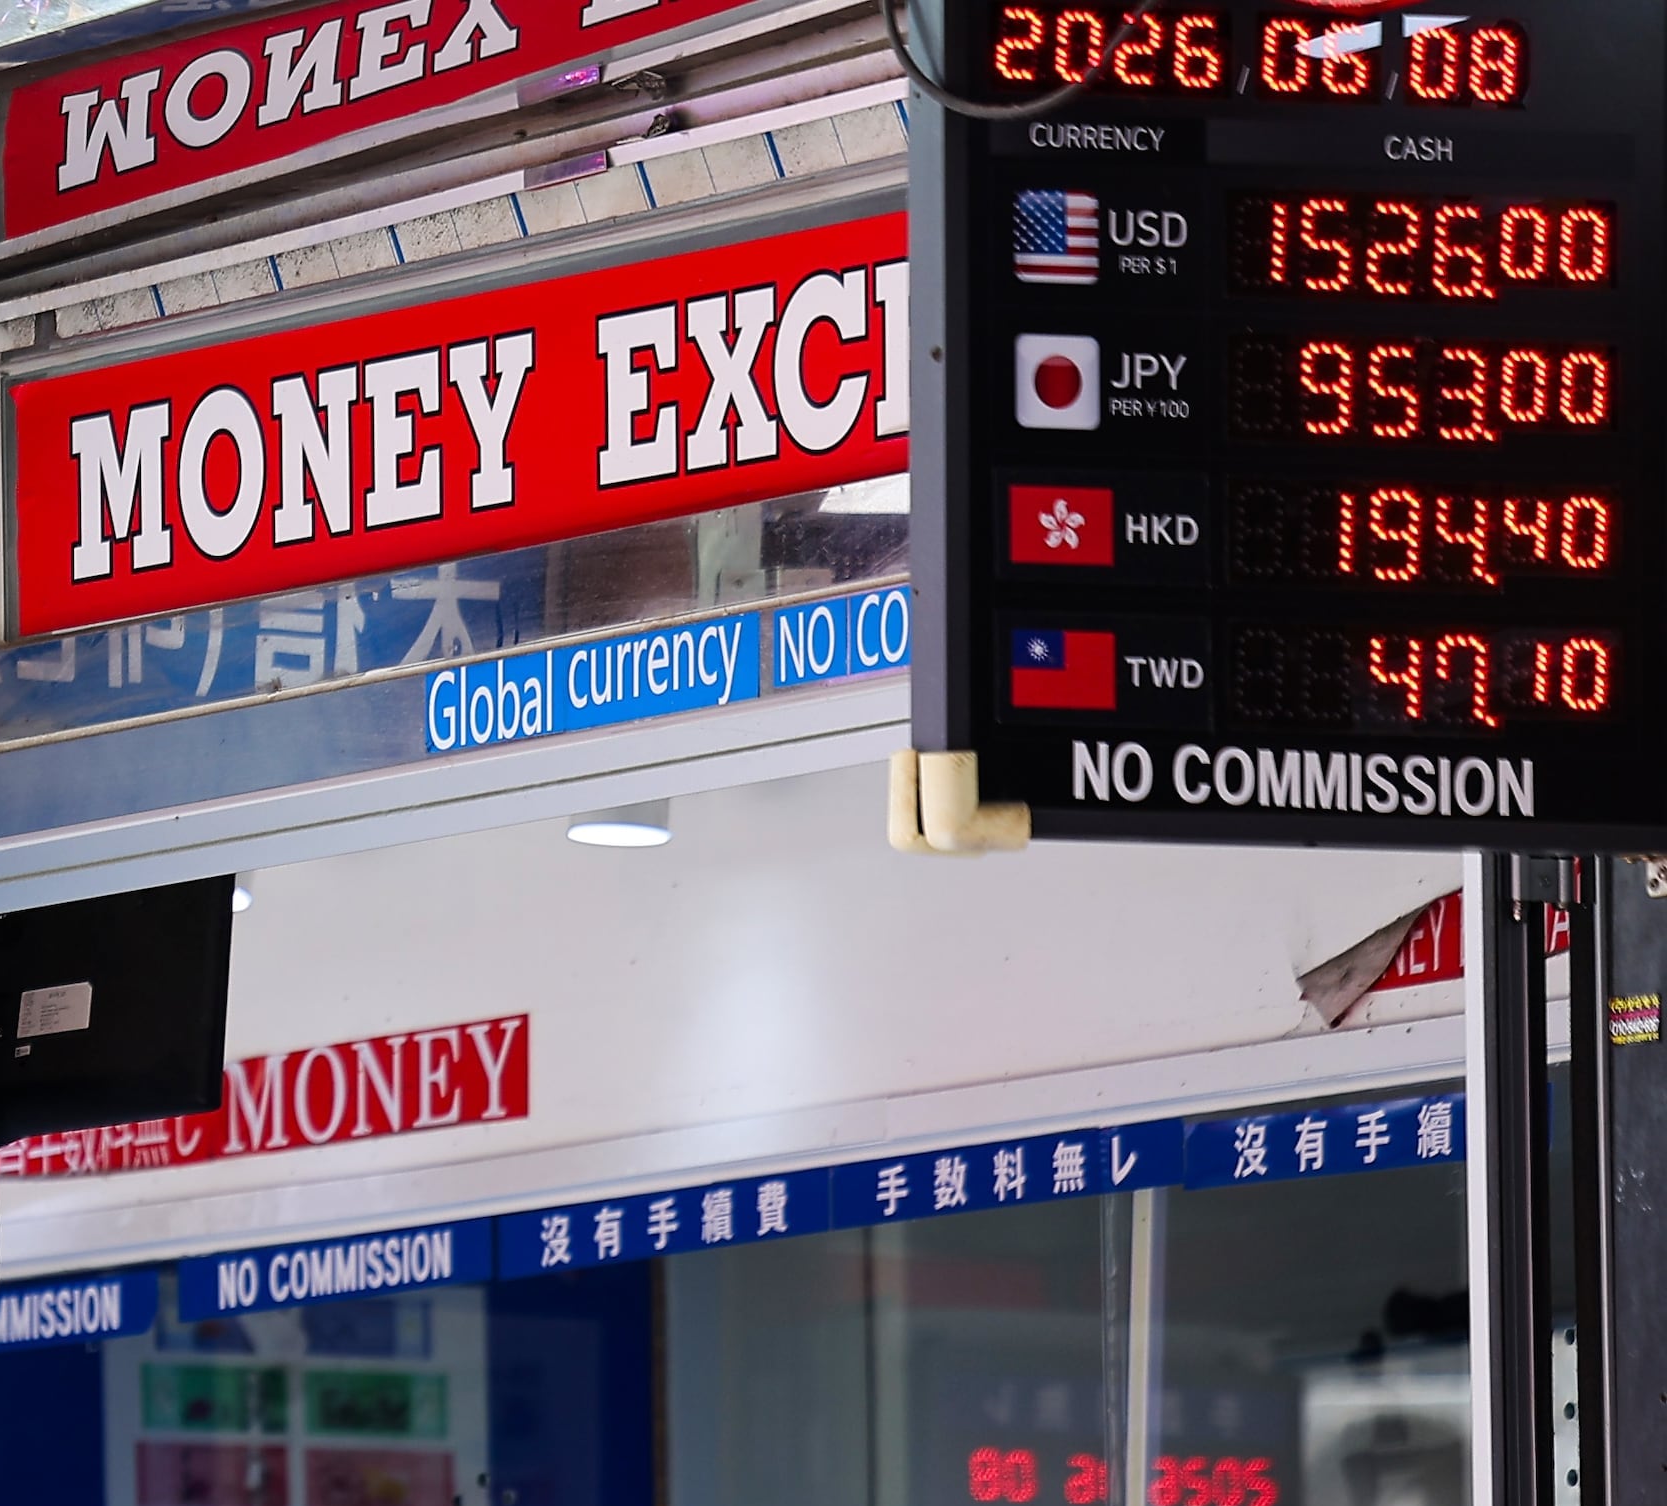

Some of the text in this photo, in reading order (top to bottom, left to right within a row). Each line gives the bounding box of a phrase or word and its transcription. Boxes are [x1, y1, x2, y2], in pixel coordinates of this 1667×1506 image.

[1408, 26, 1517, 102] 08
[1028, 122, 1454, 163] CURRENCY CASH
[1108, 208, 1189, 250] USD
[1120, 256, 1150, 275] PER
[1109, 353, 1188, 391] JPY
[1109, 399, 1142, 419] PER
[70, 328, 535, 583] MONEY
[1125, 514, 1200, 547] HKD
[427, 664, 553, 752] Global
[568, 621, 742, 715] currency
[777, 609, 835, 679] NO
[1125, 656, 1205, 690] TWD
[1072, 740, 1535, 818] NO COMMISSION
[224, 1016, 521, 1155] MONEY
[217, 1259, 257, 1310] NO
[268, 1232, 453, 1305] COMMISSION
